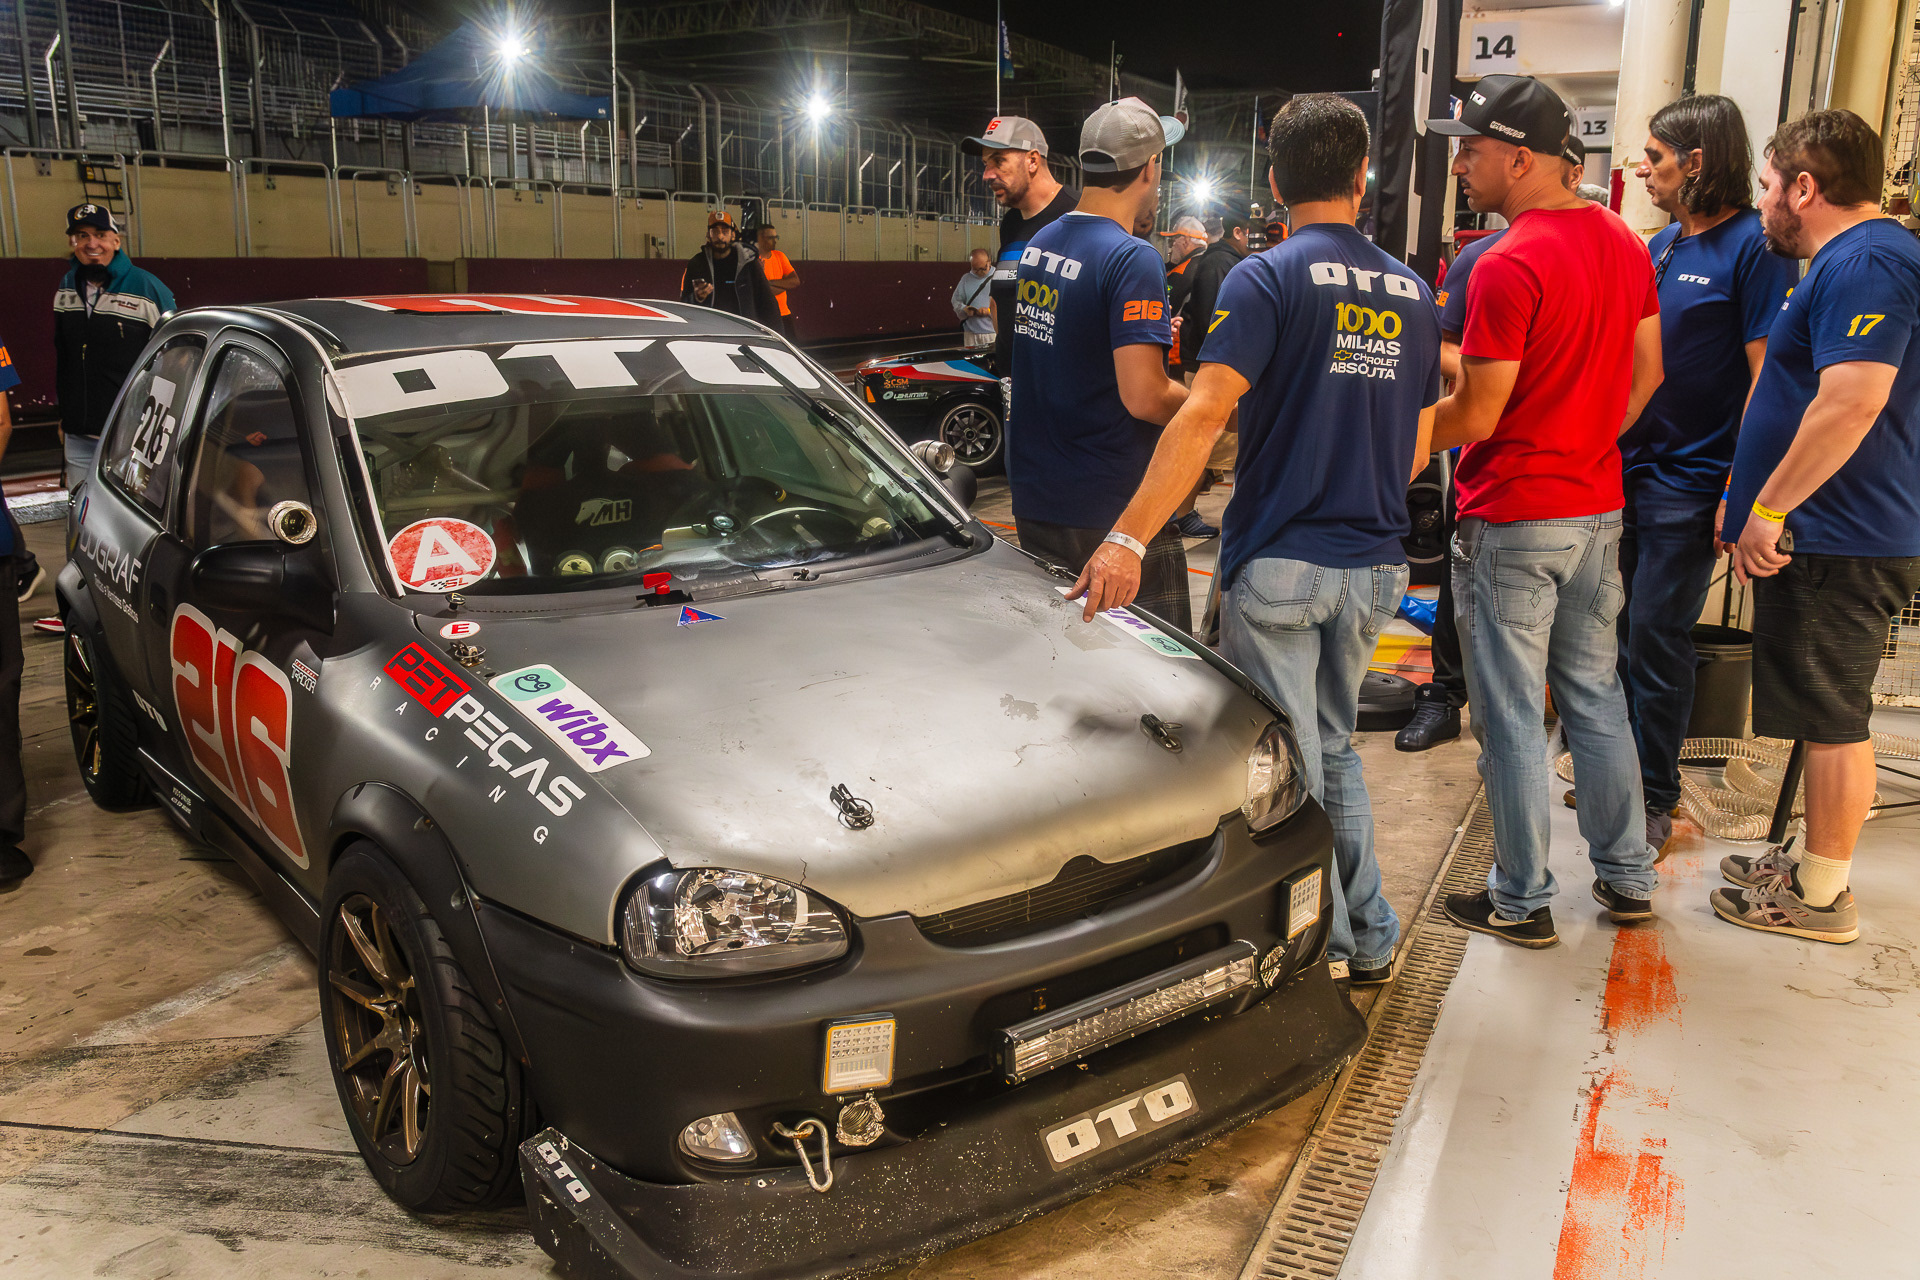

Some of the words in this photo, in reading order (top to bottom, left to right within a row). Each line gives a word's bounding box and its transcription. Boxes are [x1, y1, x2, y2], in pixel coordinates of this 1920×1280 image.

[1475, 35, 1516, 60] 14
[1583, 120, 1607, 135] 13
[1020, 246, 1083, 281] OTO
[1678, 273, 1711, 285] OTO
[1017, 278, 1059, 313] 1000
[1309, 262, 1420, 301] OTO
[1016, 302, 1056, 327] MILHAS
[1122, 299, 1164, 322] 216
[1335, 301, 1403, 340] 1000
[1846, 313, 1896, 338] 17
[1336, 333, 1402, 356] MILHAS
[327, 339, 821, 418] OTO
[409, 524, 482, 583] A
[450, 622, 471, 635] E
[132, 689, 168, 732] OTO
[170, 602, 310, 871] 216
[536, 698, 630, 766] Wibx
[1045, 1080, 1193, 1163] OTO
[536, 1141, 591, 1203] OTO
